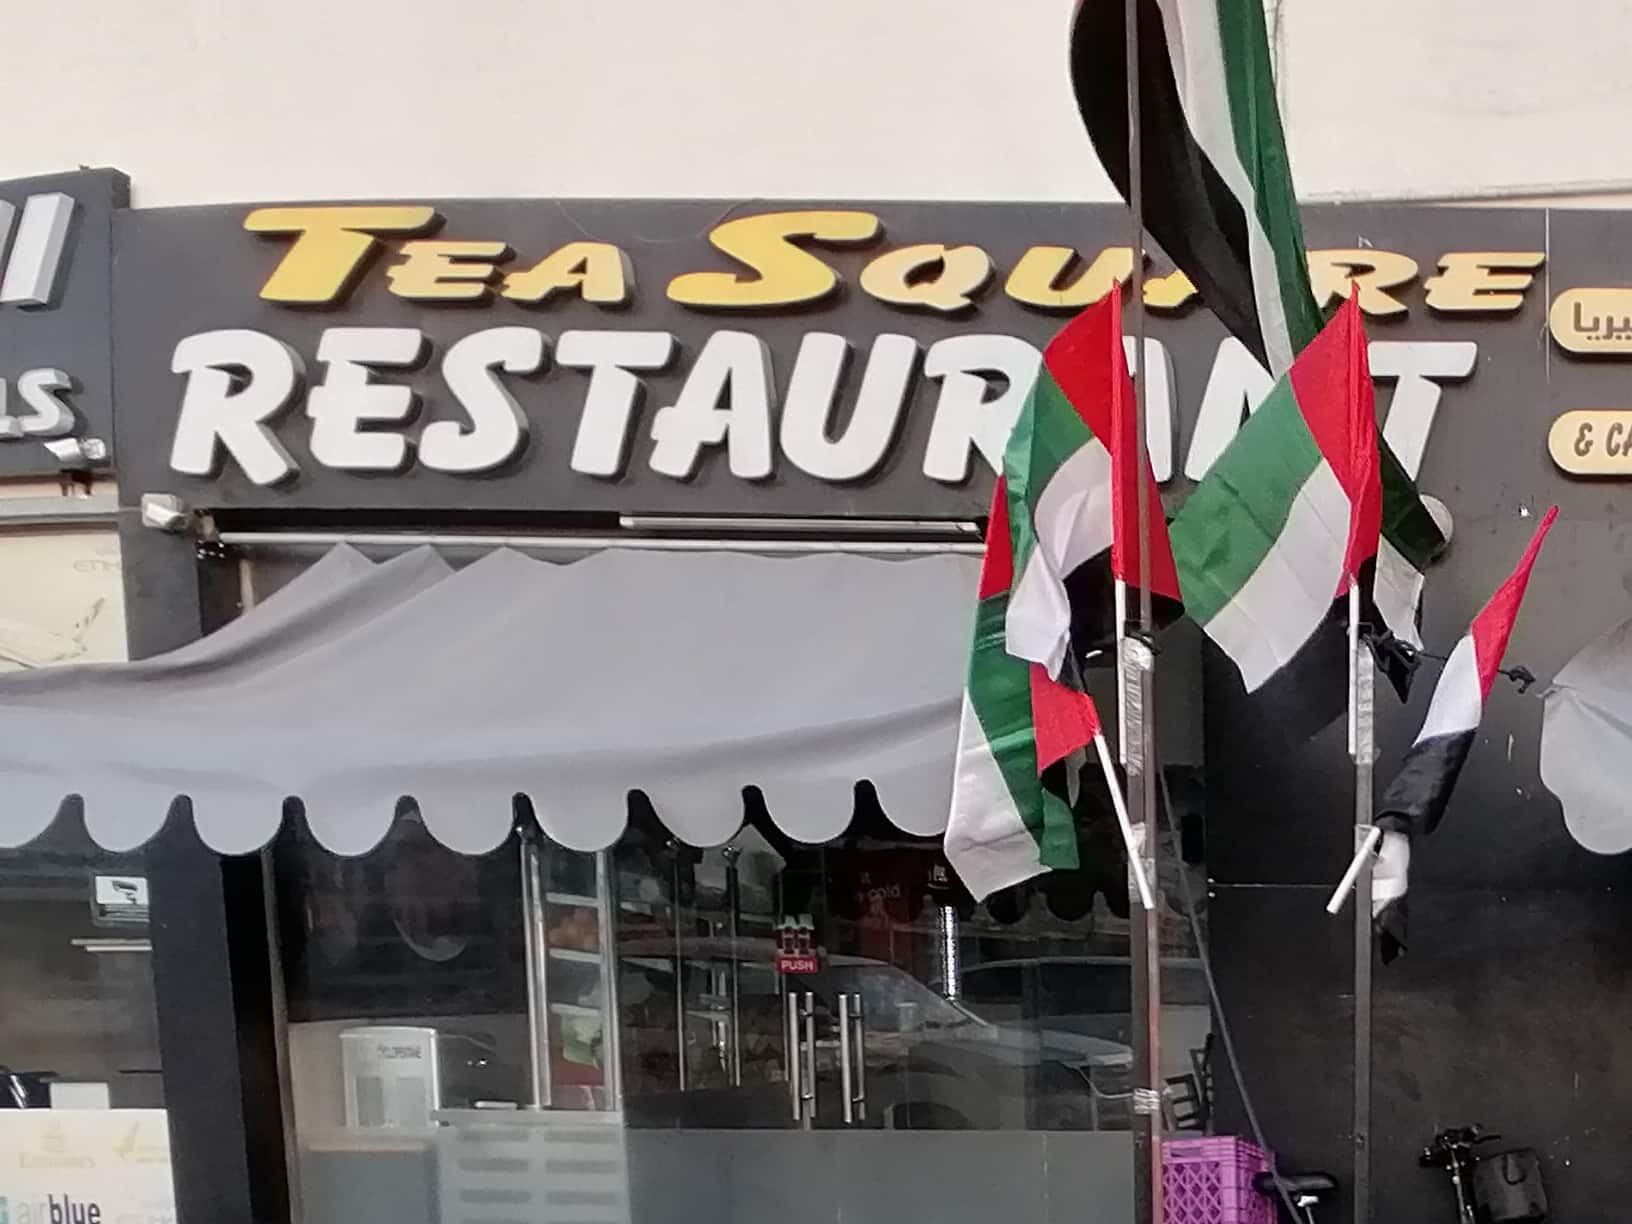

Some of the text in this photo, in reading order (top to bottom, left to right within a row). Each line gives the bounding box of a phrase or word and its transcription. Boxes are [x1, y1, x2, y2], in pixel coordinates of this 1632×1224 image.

[243, 206, 1546, 316] TEA SQURE
[1573, 422, 1594, 458] &
[781, 959, 814, 971] PUSH
